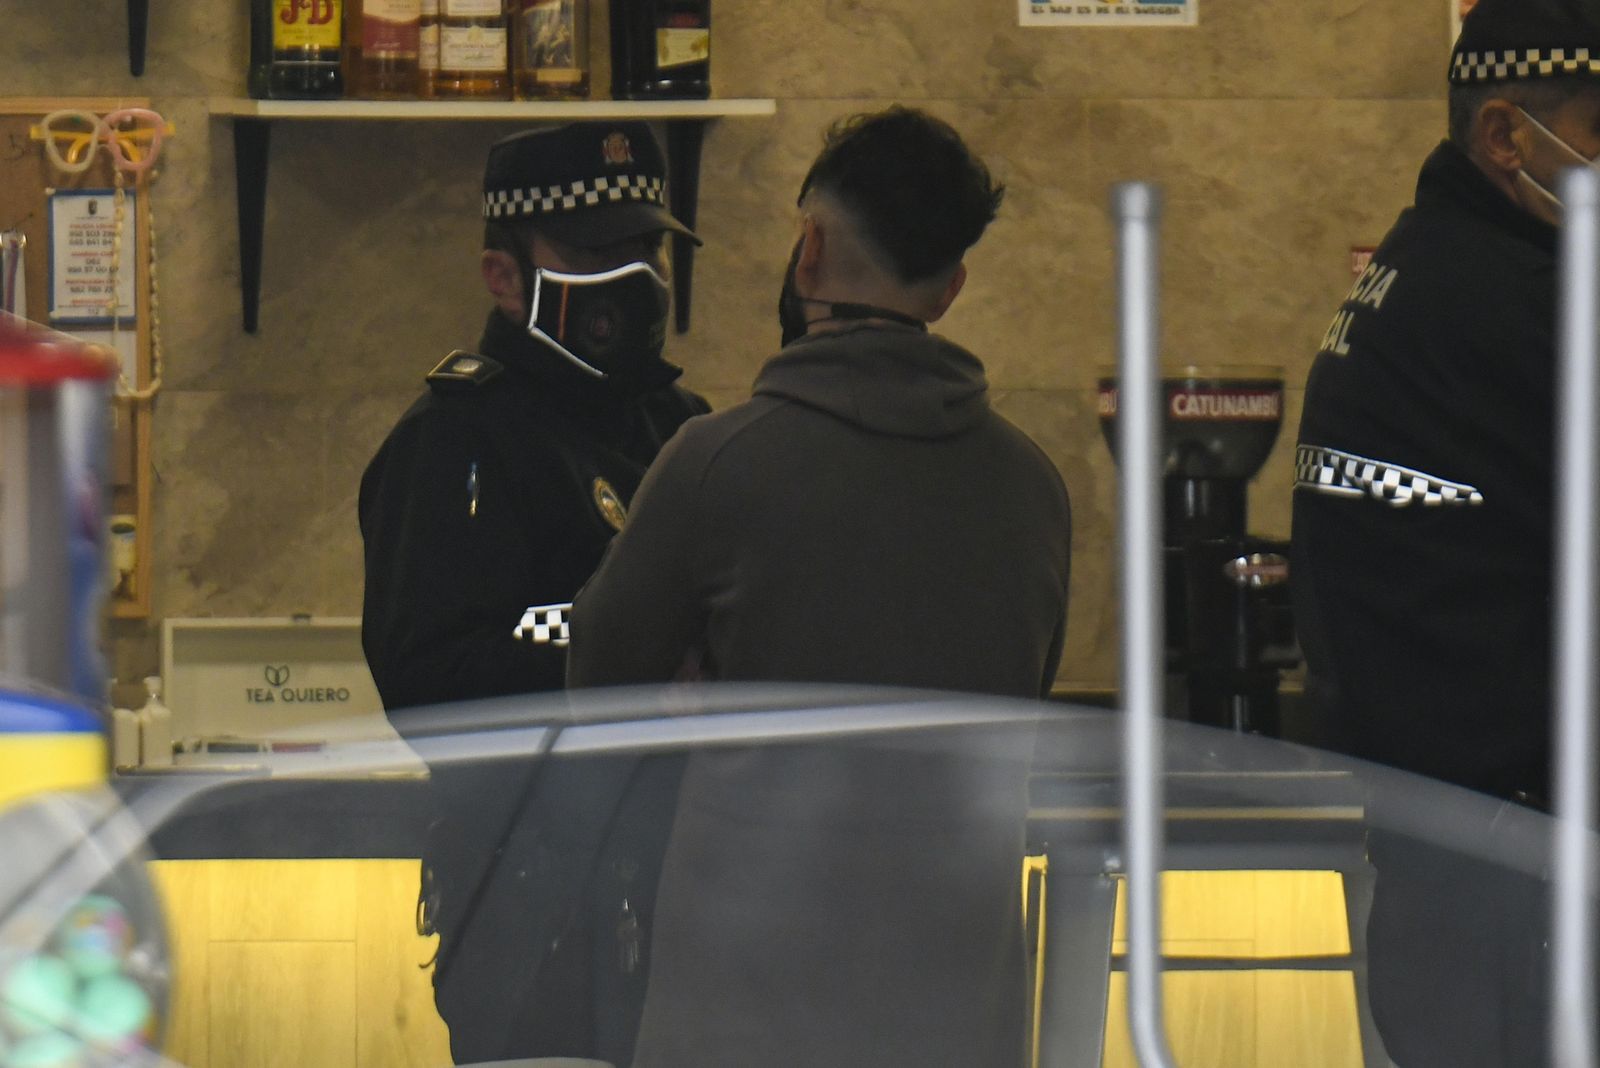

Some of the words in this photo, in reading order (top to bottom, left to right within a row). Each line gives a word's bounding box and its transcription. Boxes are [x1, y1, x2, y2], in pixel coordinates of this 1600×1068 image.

[1345, 262, 1398, 309] CIA
[1320, 310, 1355, 355] AL
[246, 688, 275, 702] TEA
[281, 687, 350, 702] QUIERO
